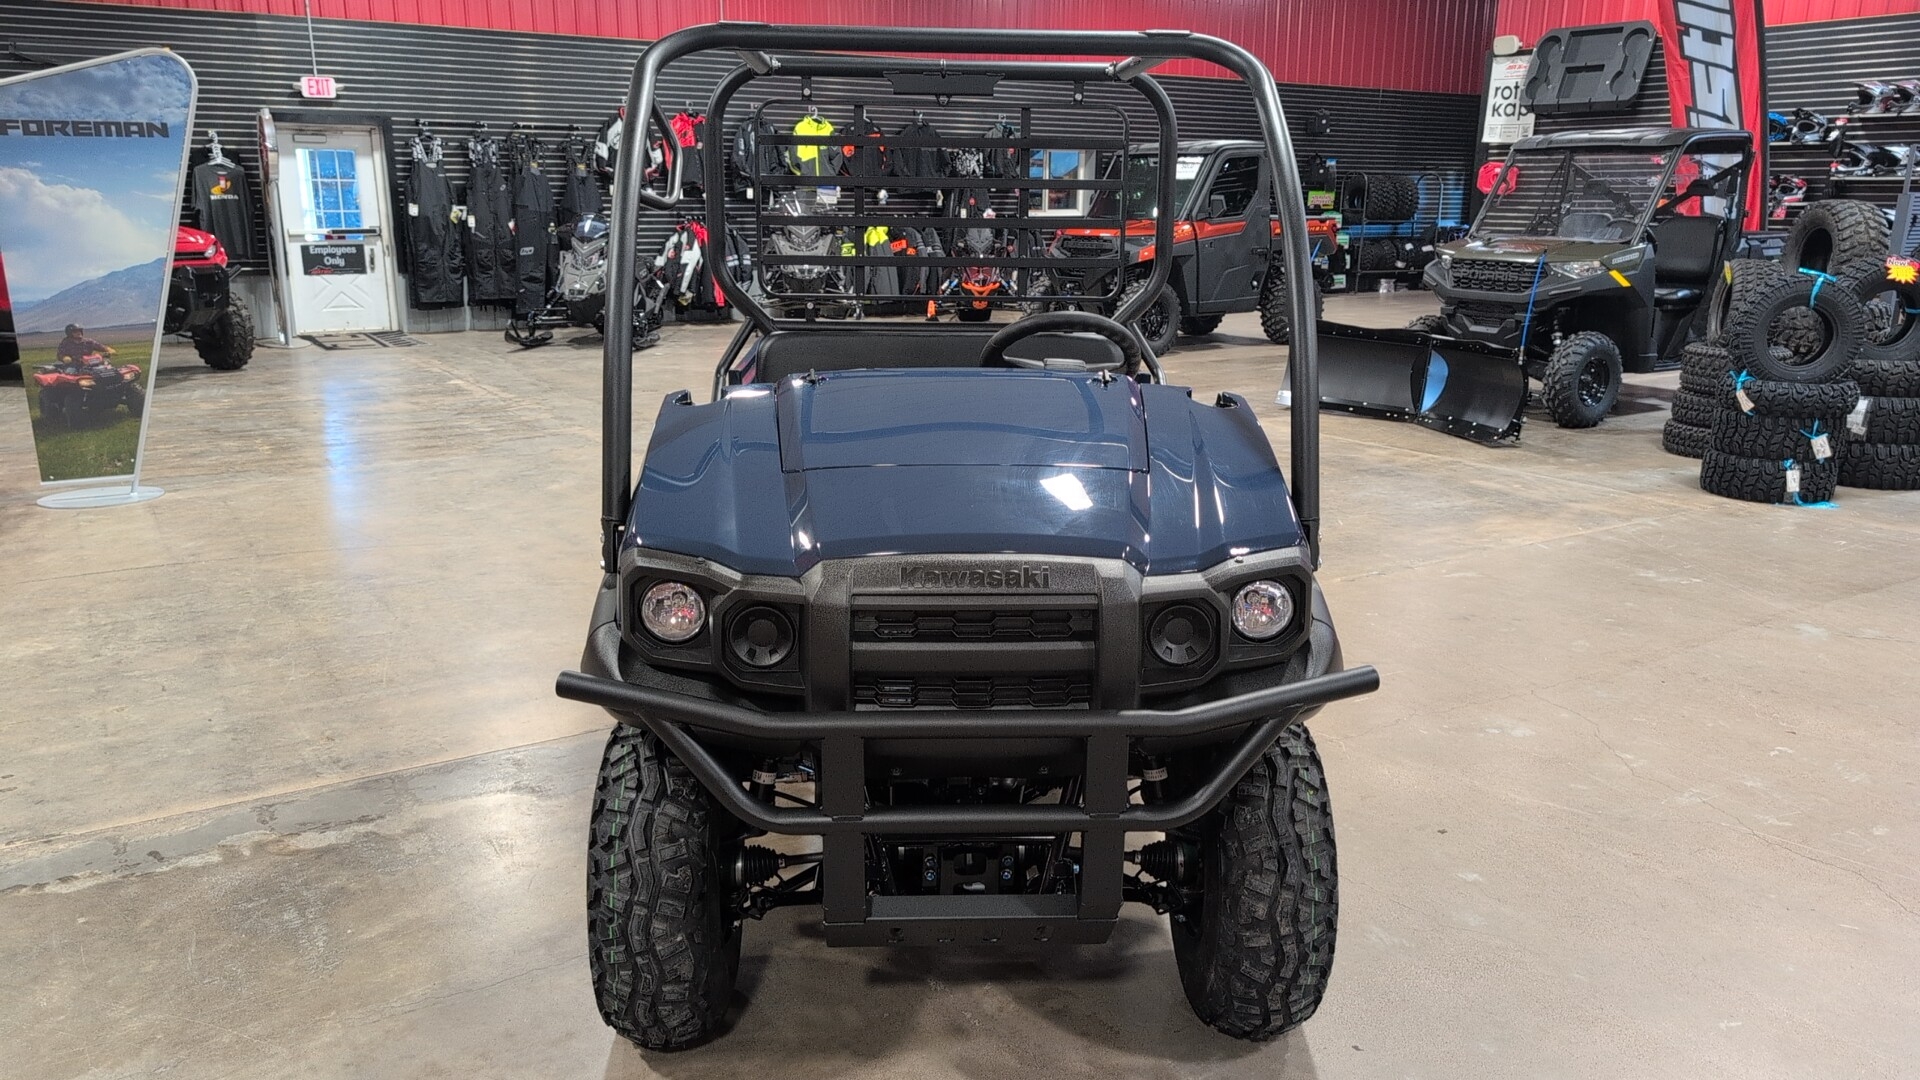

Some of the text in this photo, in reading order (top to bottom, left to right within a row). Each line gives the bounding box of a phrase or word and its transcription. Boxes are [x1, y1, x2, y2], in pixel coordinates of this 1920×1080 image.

[307, 78, 331, 96] EXIT
[0, 119, 169, 138] FOREMAN
[309, 245, 357, 256] Employees
[323, 256, 345, 267] Only
[1460, 268, 1519, 282] POLARIS
[900, 565, 1050, 589] Kawasaki
